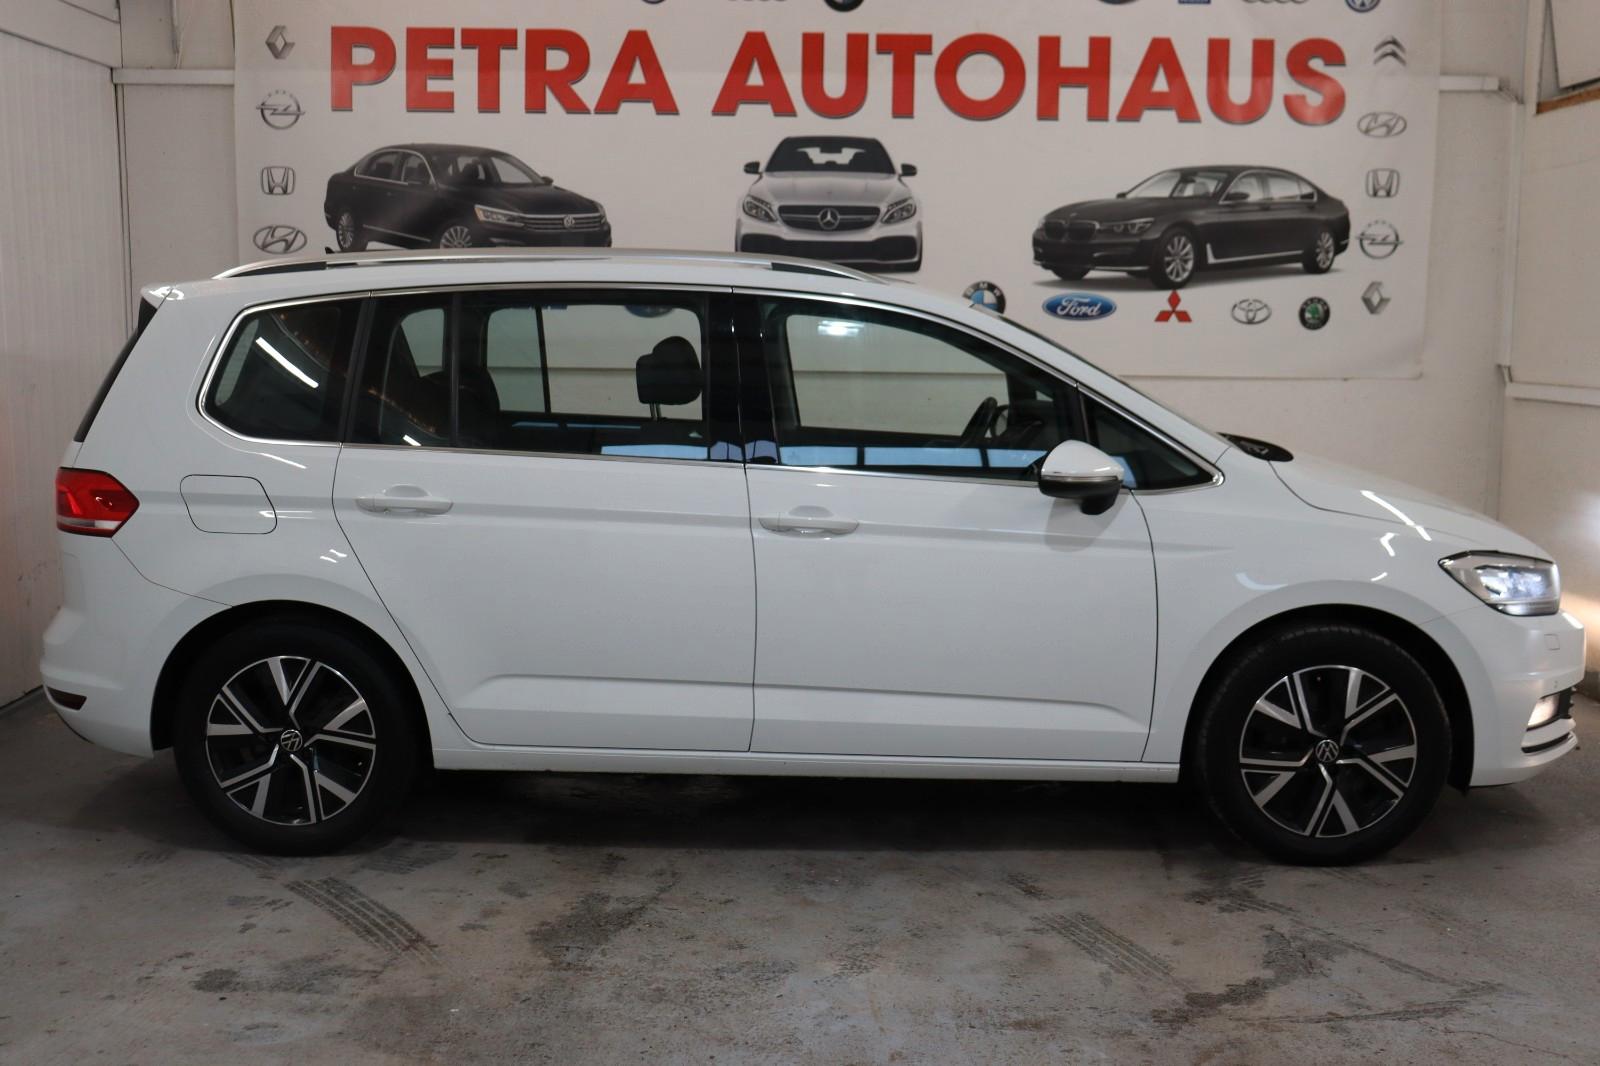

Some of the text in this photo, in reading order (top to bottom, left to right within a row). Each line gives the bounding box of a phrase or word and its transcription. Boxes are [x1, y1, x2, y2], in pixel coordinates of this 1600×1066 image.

[331, 26, 1347, 125] PETRA AUTOHAUS
[965, 282, 1001, 297] BMW
[1056, 297, 1102, 317] Ford
